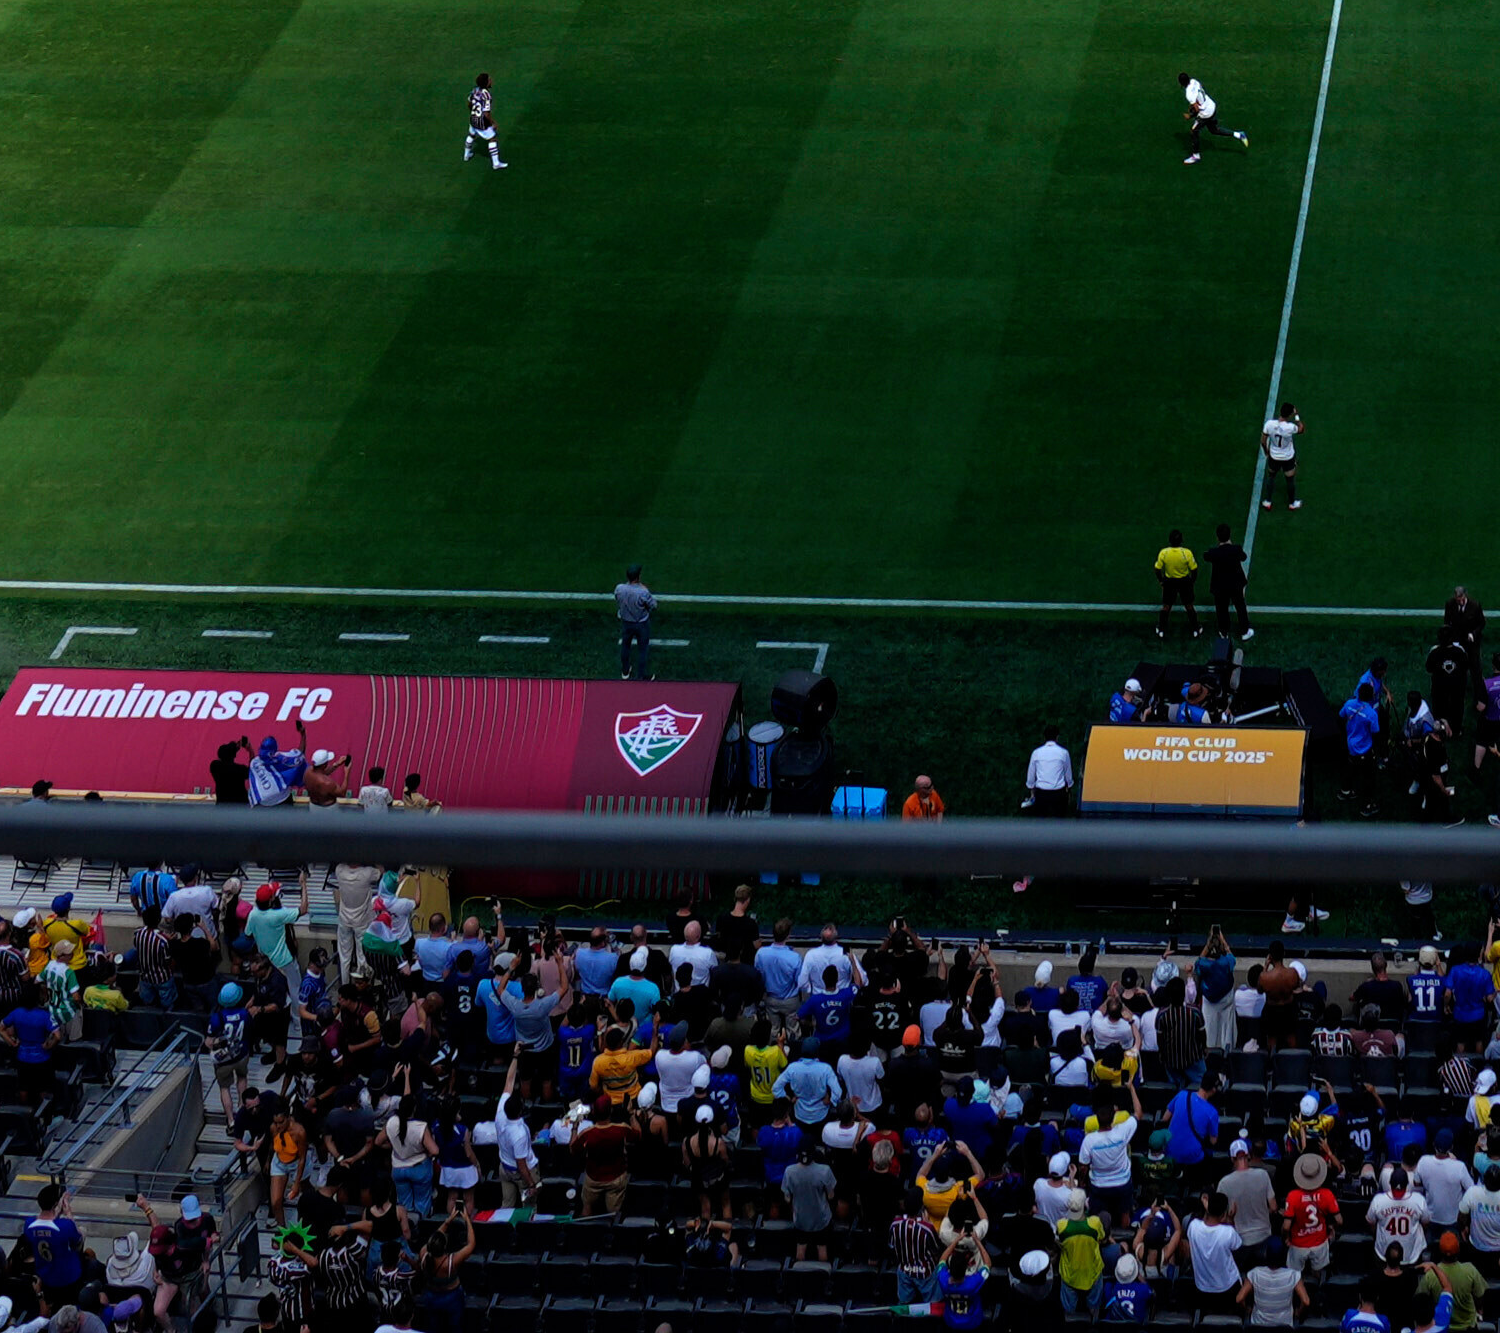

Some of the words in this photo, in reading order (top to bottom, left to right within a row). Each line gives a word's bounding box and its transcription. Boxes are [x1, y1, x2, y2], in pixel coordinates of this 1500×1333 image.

[15, 682, 270, 721] Fluminense
[276, 687, 333, 722] FC
[1154, 736, 1192, 748] FIFA
[1194, 736, 1237, 749] CLUB
[1123, 748, 1186, 762] WORLD
[1188, 749, 1221, 763] CUP
[1417, 985, 1438, 1012] 11
[1385, 1217, 1410, 1236] 40
